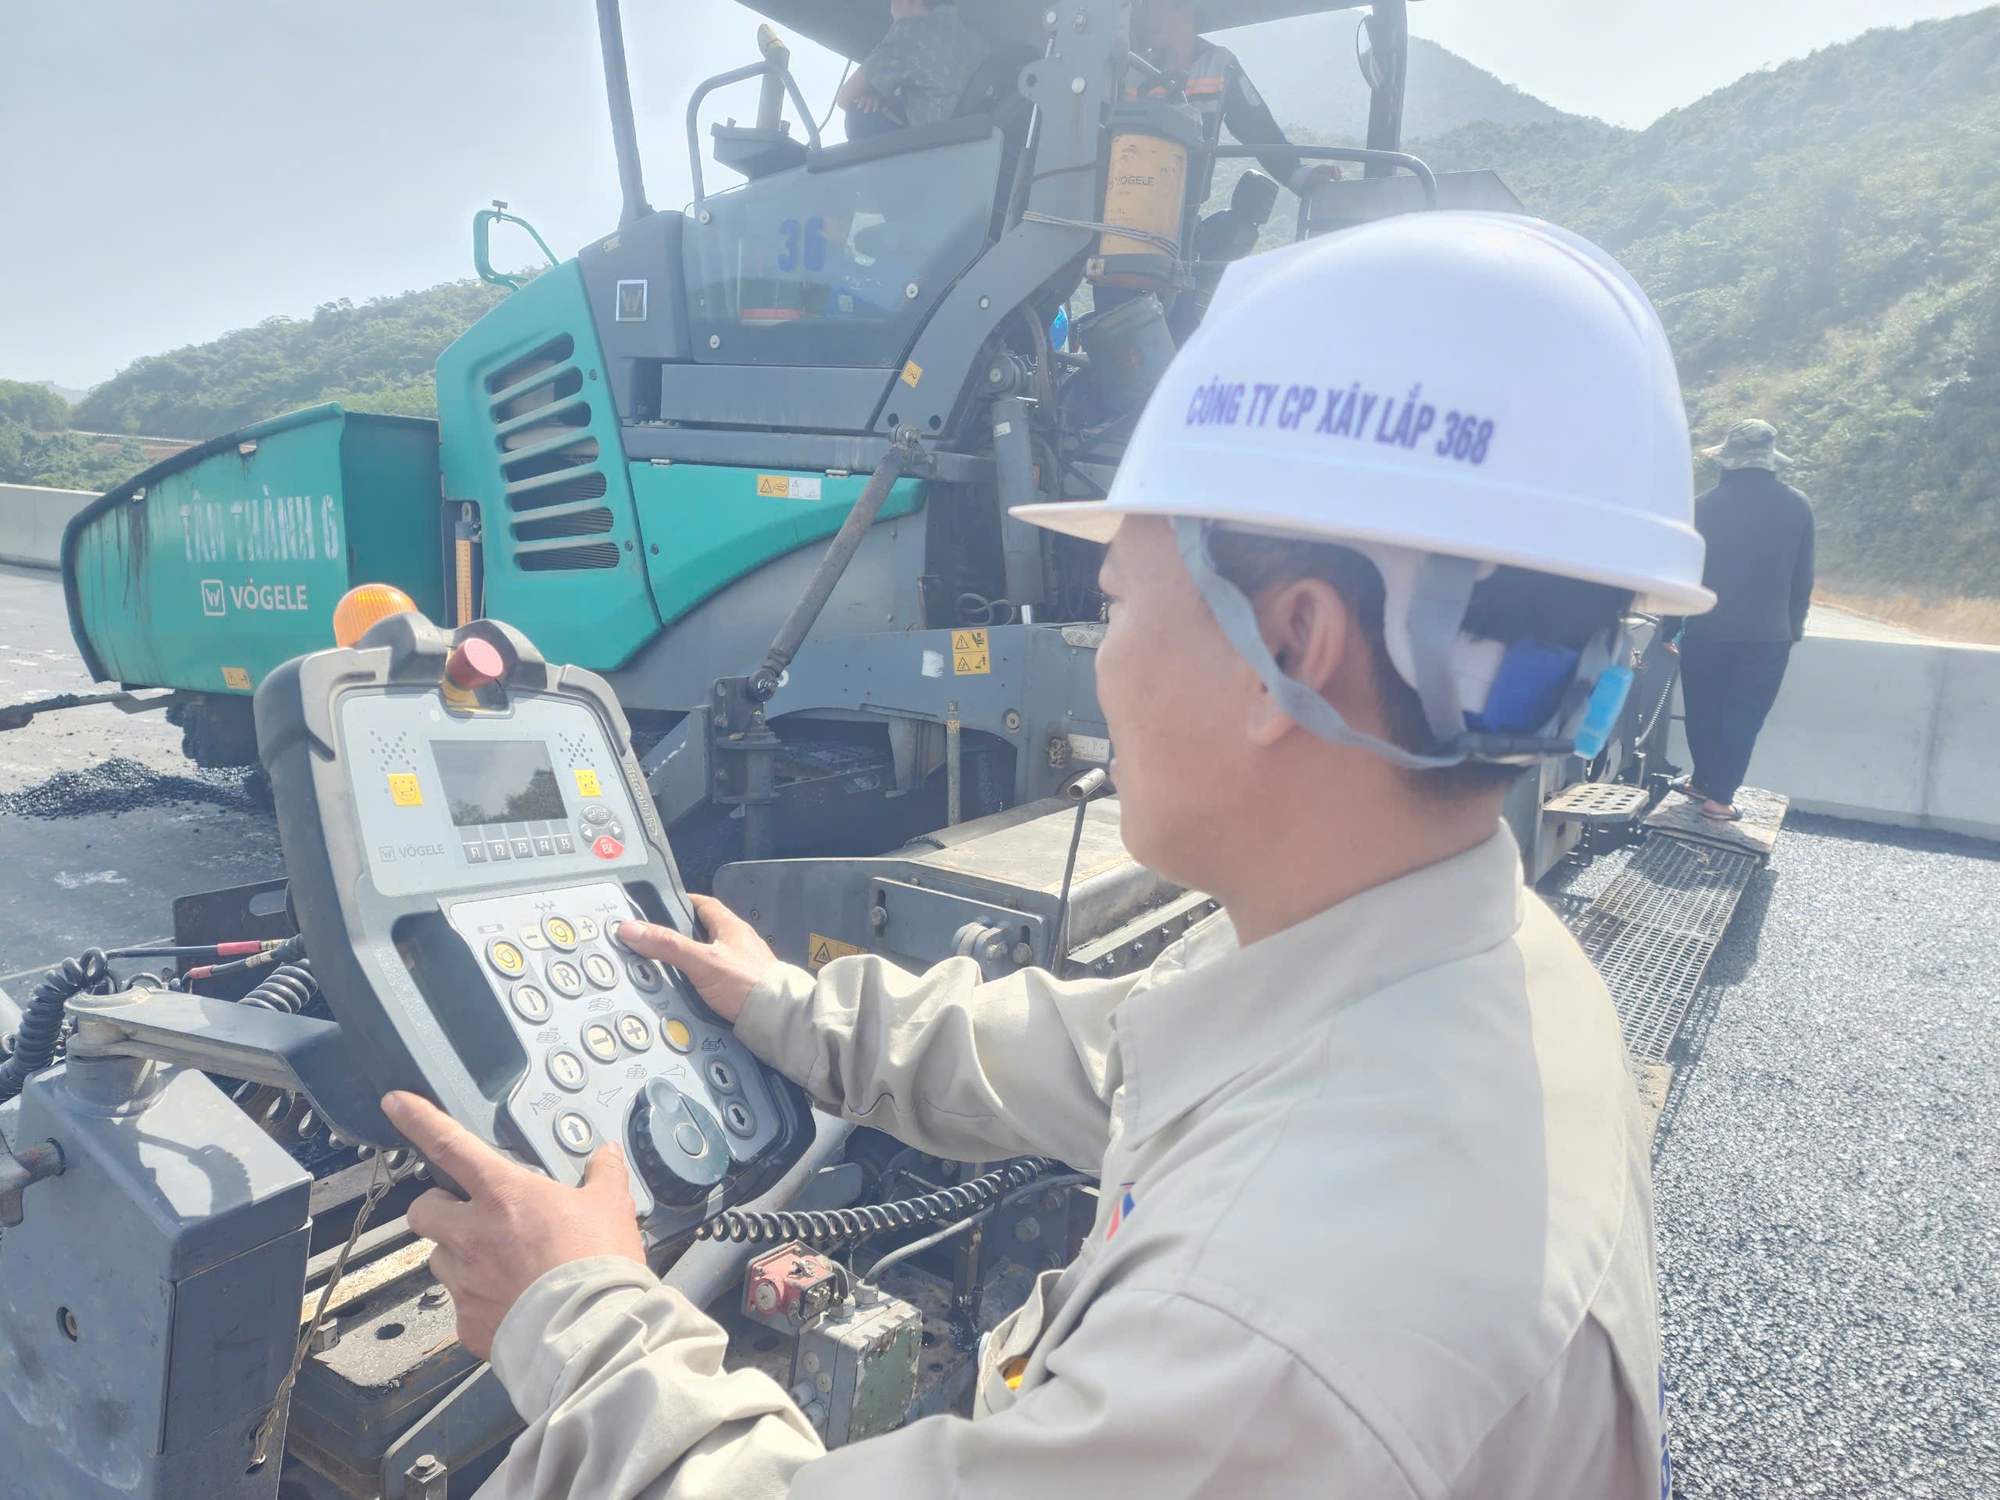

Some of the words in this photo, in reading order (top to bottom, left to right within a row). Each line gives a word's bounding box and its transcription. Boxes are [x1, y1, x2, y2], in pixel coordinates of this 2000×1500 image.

[777, 217, 827, 273] 36
[1246, 383, 1280, 428] TY
[1278, 384, 1318, 430] CP
[1315, 381, 1378, 439] XÂY
[1436, 410, 1495, 466] 368
[230, 578, 309, 610] VÖGELE
[398, 843, 446, 859] VÖGELE
[470, 846, 482, 859] F1
[494, 844, 506, 857] F2
[517, 842, 529, 855] F3
[540, 840, 551, 853] F4
[561, 838, 572, 850] F5
[601, 843, 615, 855] ESC
[556, 967, 577, 988] R
